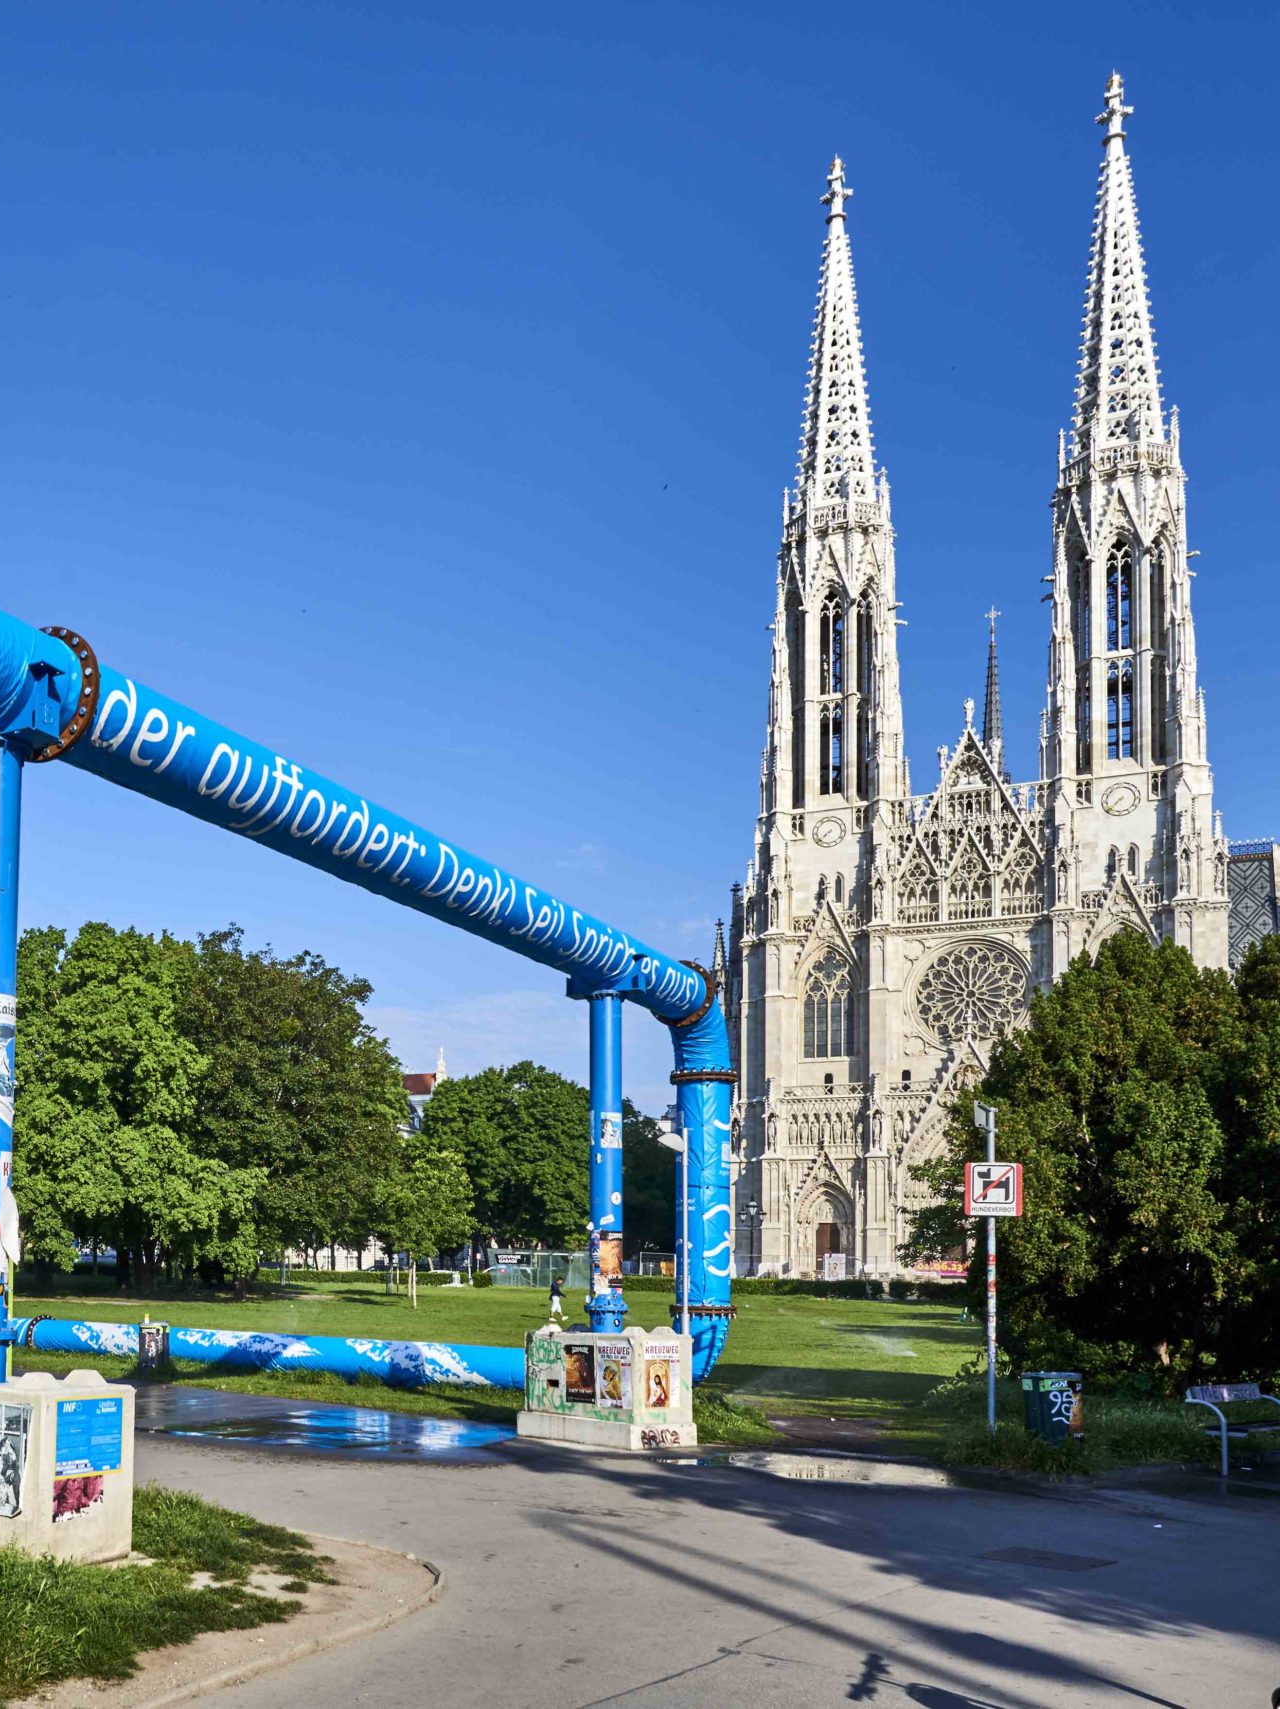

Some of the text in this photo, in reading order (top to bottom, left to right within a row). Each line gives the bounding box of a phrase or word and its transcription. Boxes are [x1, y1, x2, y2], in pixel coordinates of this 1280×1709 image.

[90, 678, 196, 774] der
[197, 742, 427, 886] auffordert:
[420, 842, 516, 927] Denk!
[508, 886, 565, 947] Sei!
[558, 910, 637, 981] Sprich
[656, 966, 699, 1010] aus!
[598, 1346, 630, 1356] KREUZWEG
[645, 1345, 679, 1354] KREUZWEG
